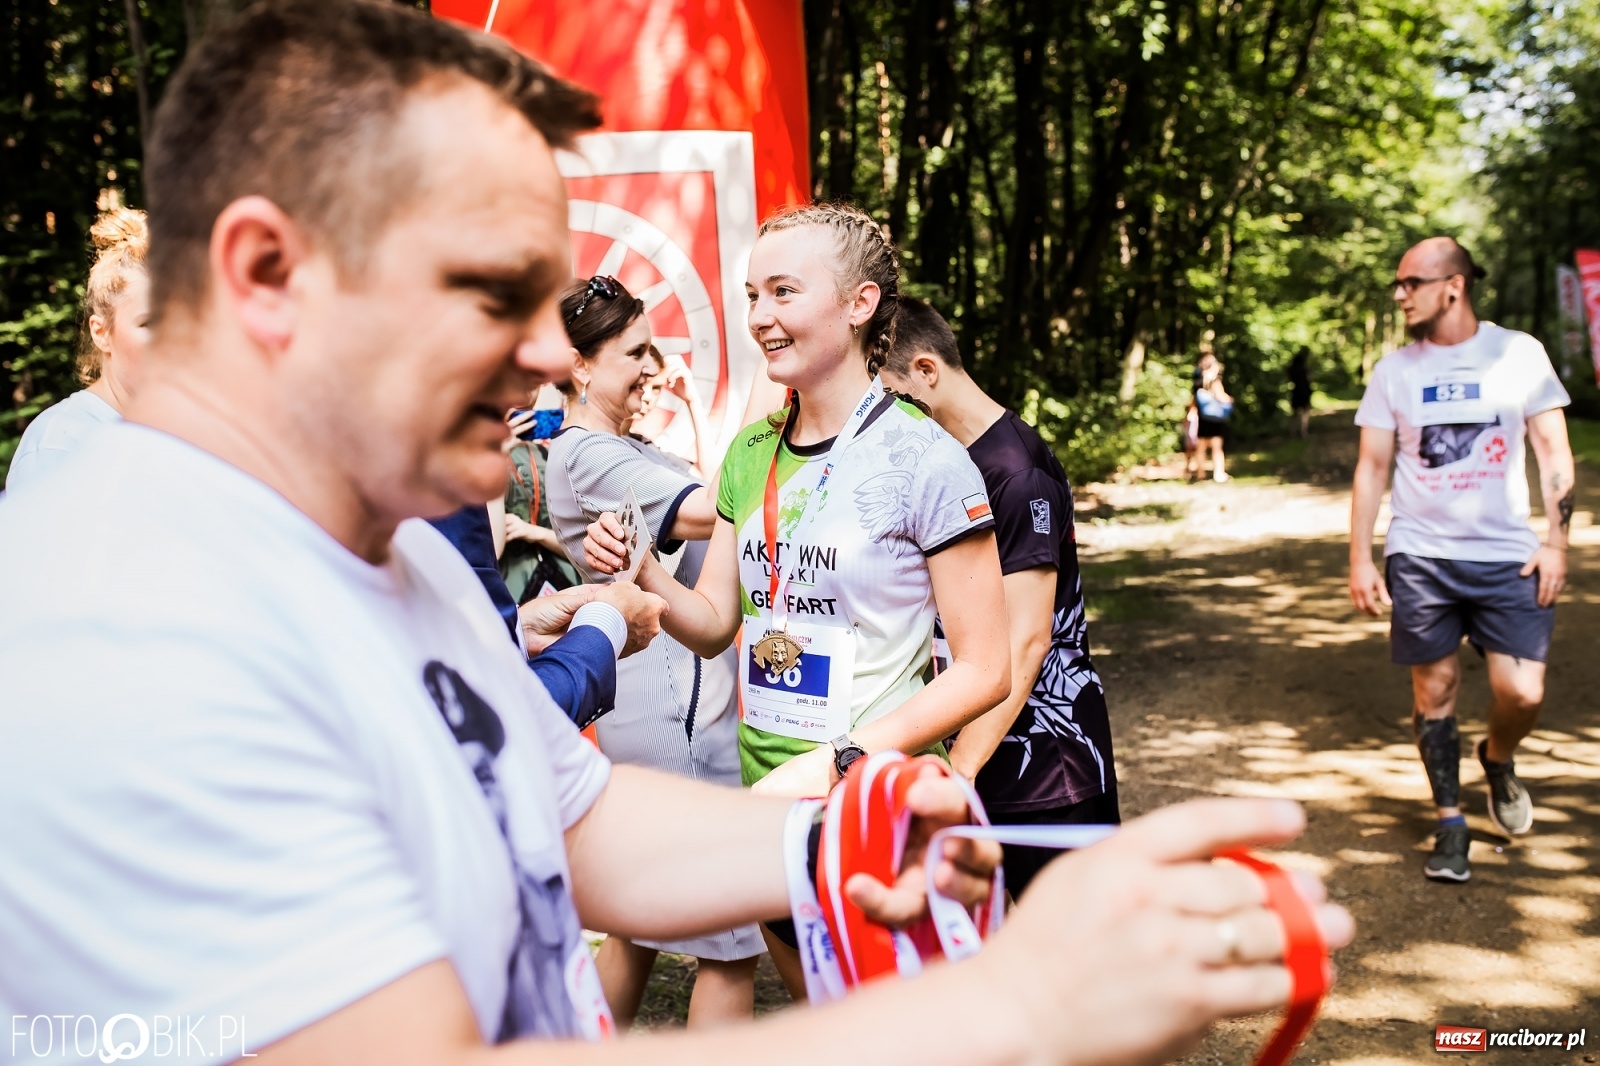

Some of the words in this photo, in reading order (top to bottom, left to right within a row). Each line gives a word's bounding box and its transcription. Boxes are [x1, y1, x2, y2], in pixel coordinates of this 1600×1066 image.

[855, 392, 876, 418] PGNiG
[742, 538, 837, 571] AKTWNI
[750, 589, 837, 615] GEFART
